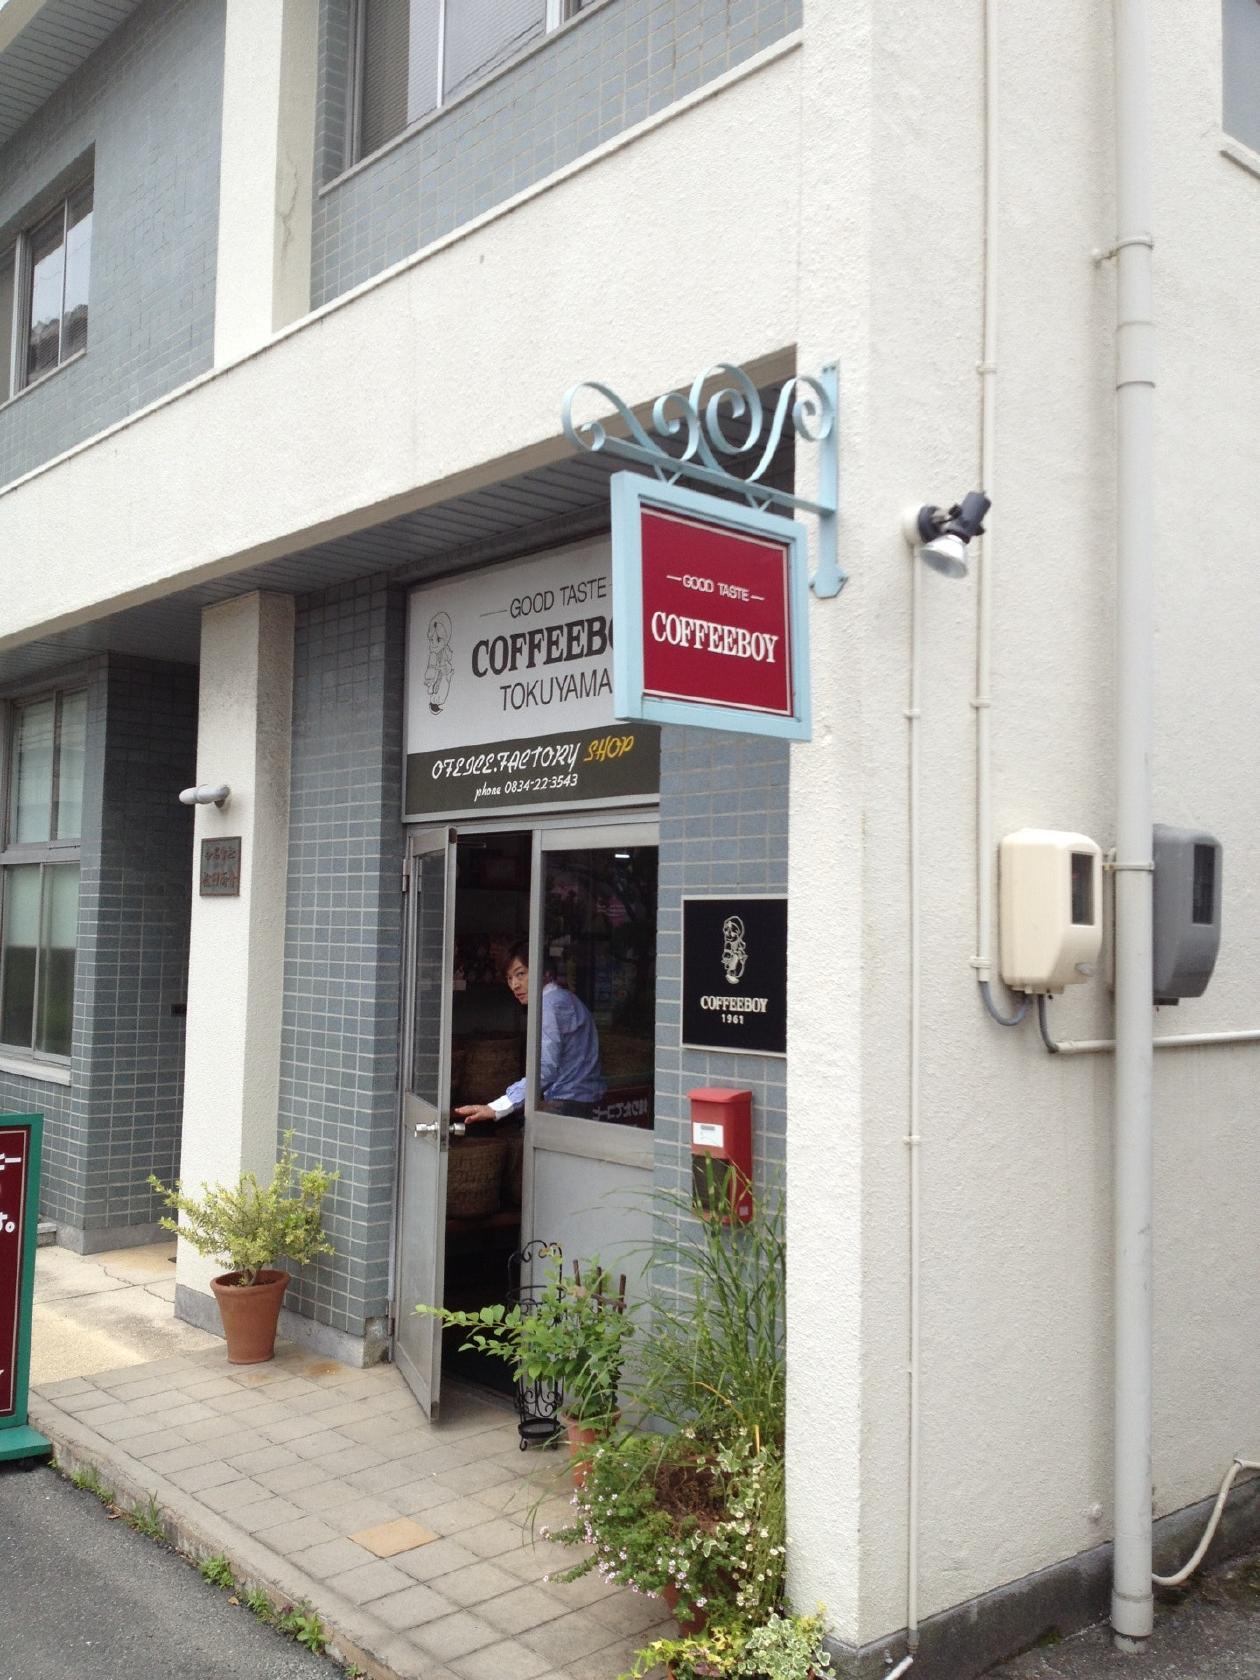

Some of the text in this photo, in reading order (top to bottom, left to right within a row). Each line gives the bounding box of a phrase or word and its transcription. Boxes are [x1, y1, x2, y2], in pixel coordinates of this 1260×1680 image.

[510, 576, 607, 618] GOOD TASTE
[683, 574, 750, 602] GOOD TASTE
[651, 611, 779, 663] COFFEEBOY
[500, 667, 613, 711] TOKUYAMA
[583, 735, 635, 763] SHOP
[474, 773, 579, 802] phone 0834-22-3543
[700, 995, 769, 1013] COFFEEBOY
